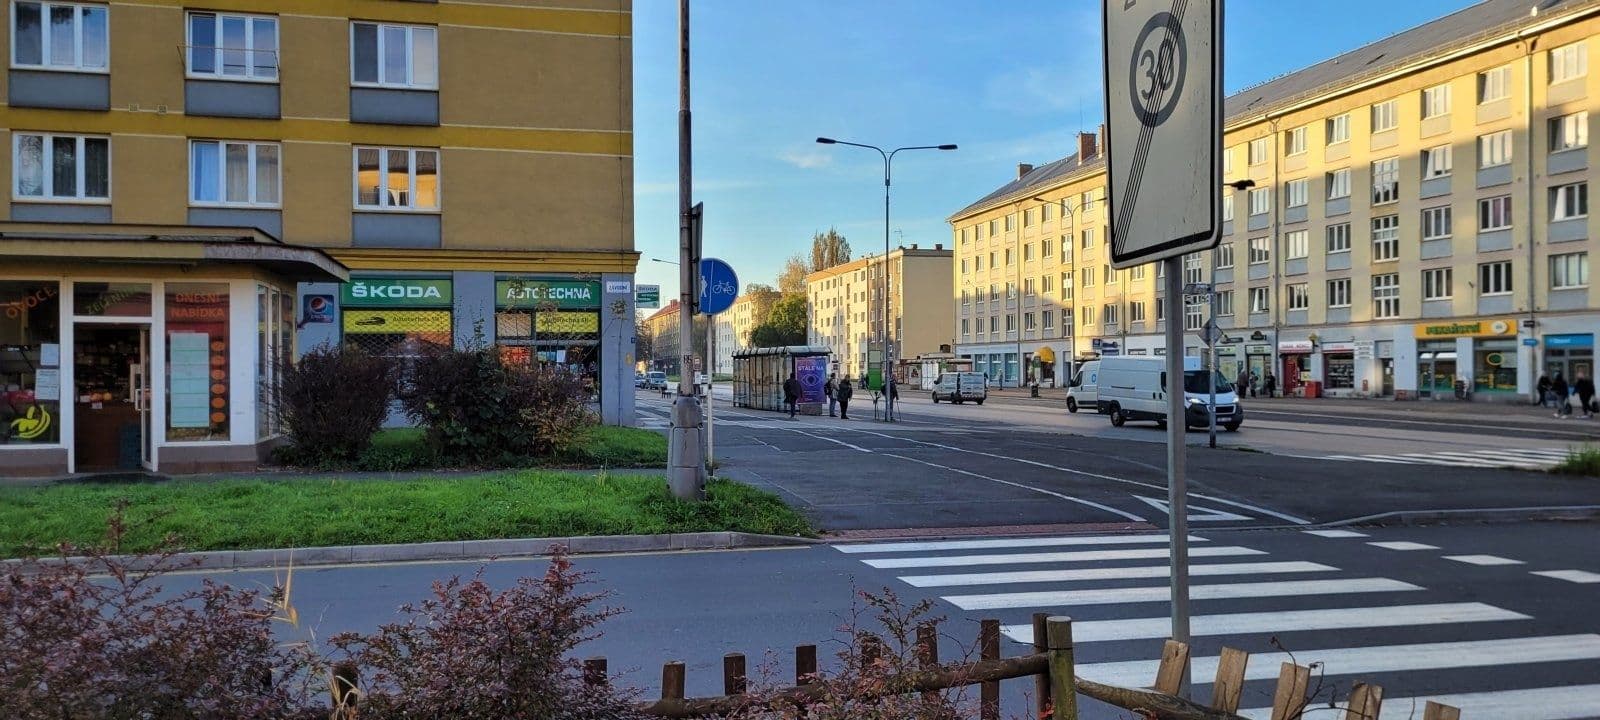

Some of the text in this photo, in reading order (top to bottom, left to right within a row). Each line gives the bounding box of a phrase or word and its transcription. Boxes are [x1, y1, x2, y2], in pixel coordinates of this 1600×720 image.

[1140, 38, 1174, 100] 30
[352, 282, 441, 298] ŠKODA
[507, 287, 591, 299] AUTOTECHNA
[6, 286, 55, 319] OVOCE
